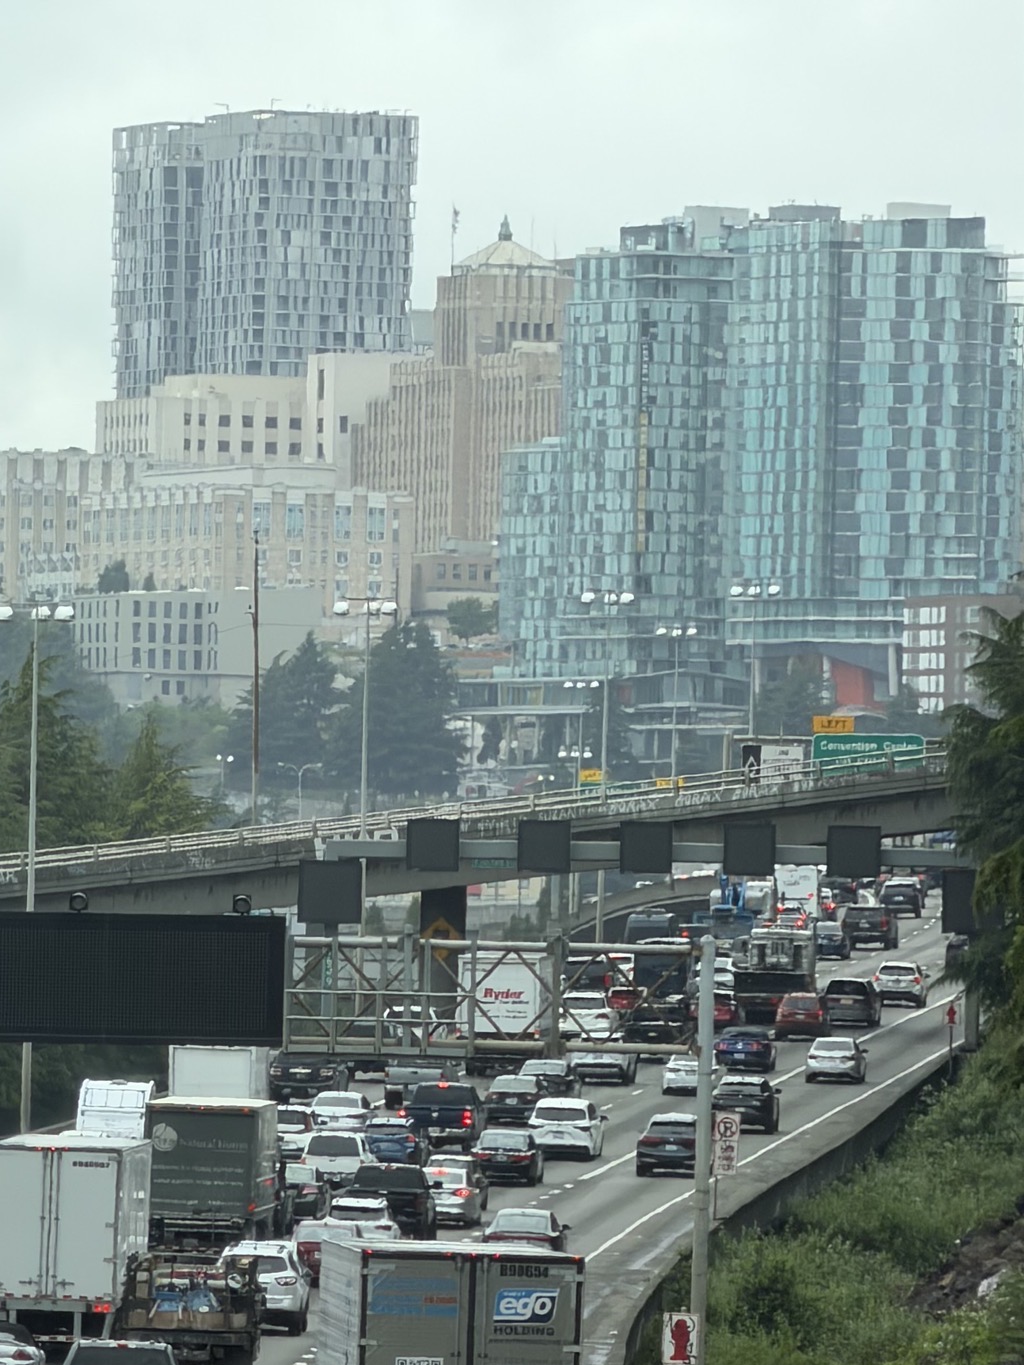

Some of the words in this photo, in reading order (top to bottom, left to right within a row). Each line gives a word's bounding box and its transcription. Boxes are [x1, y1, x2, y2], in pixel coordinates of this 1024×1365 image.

[821, 719, 848, 729] LEFT
[820, 741, 878, 751] Convention
[499, 1297, 553, 1320] ego
[493, 1325, 555, 1336] HOLDING
